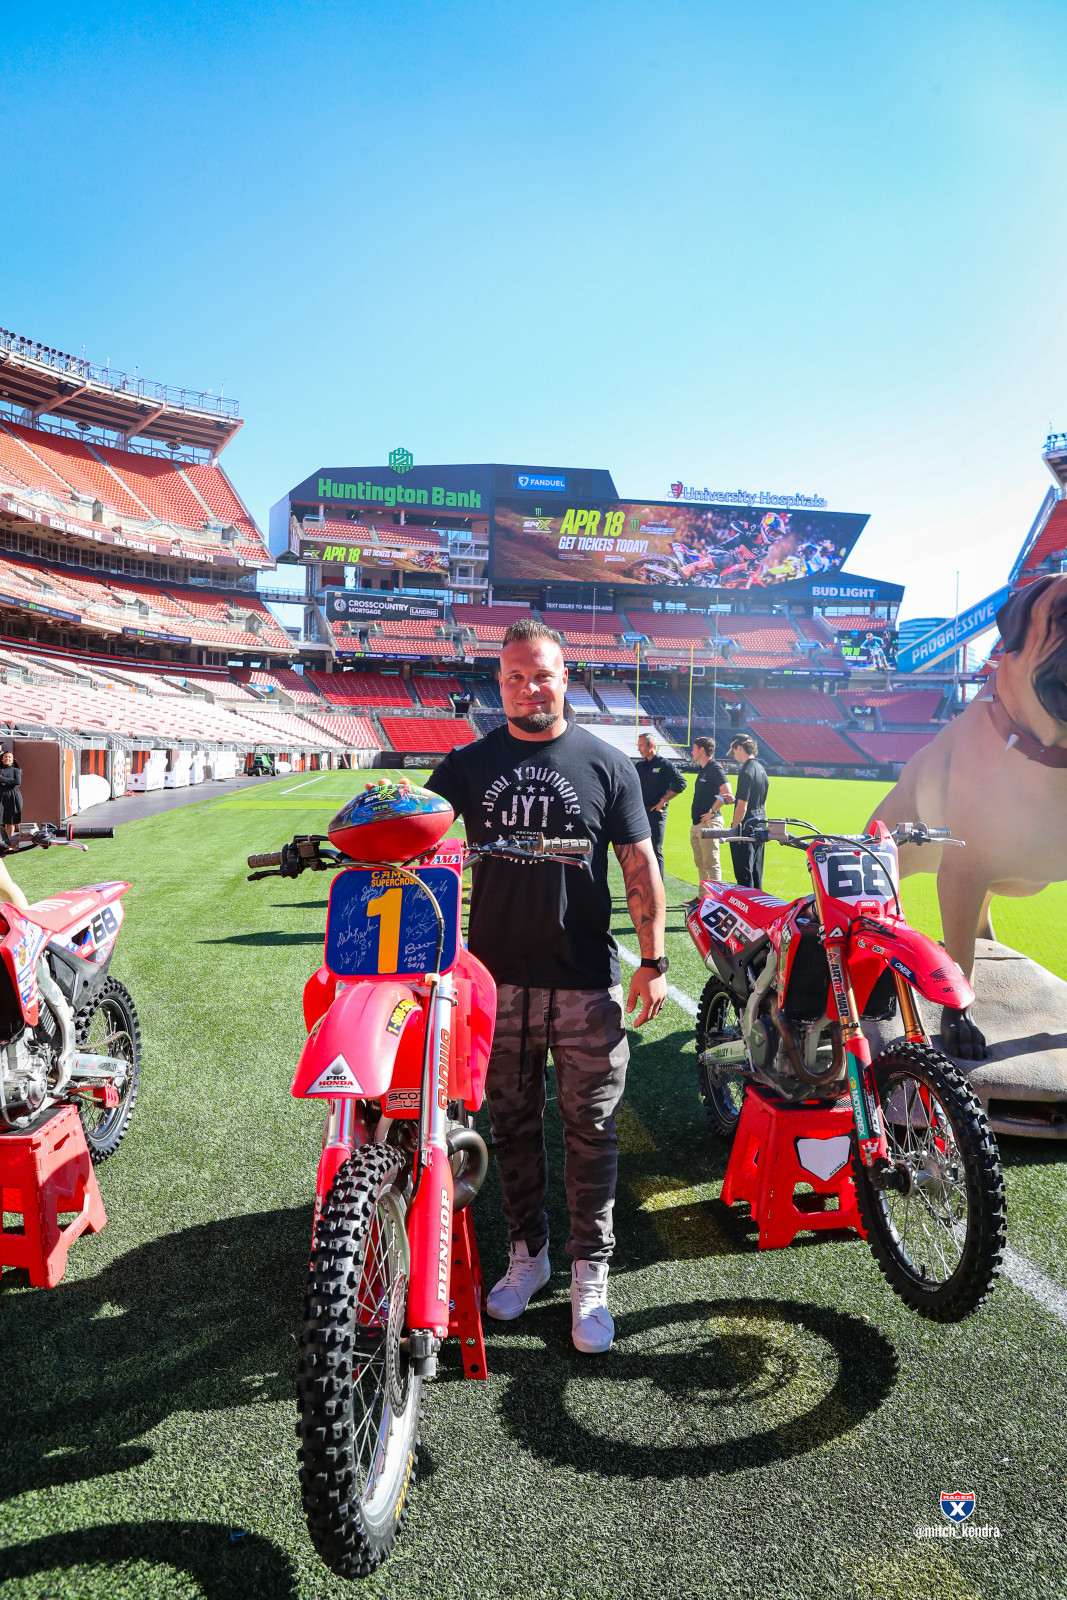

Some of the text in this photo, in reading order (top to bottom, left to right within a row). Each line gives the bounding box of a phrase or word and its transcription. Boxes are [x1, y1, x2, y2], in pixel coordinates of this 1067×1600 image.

[530, 479, 565, 487] FANDUEL
[318, 478, 482, 509] Huntington Bank
[683, 486, 825, 509] University Hospitals
[523, 519, 552, 531] SMX
[559, 508, 626, 537] APR 18
[558, 536, 649, 553] GET TICKETS TODAY!
[169, 549, 214, 563] JOE THOMAS 73
[322, 545, 347, 561] APR
[347, 547, 361, 563] 18
[812, 586, 876, 598] BUD LIGHT
[348, 599, 409, 612] CROSSCOUNTRY
[348, 606, 382, 616] MORTGAGE
[411, 608, 437, 617] LANDING
[912, 601, 996, 664] PROGRESSIVE
[364, 788, 395, 804] SMX
[501, 794, 555, 828] JYT
[431, 855, 460, 865] AMA
[371, 877, 419, 887] SUPERCROS
[827, 855, 895, 898] 68
[728, 896, 749, 914] HONDA
[91, 906, 120, 945] 68
[366, 887, 403, 974] 1
[690, 919, 703, 938] HGS
[701, 905, 738, 939] 68
[388, 1092, 422, 1102] SCO
[851, 1089, 866, 1137] MOTOREX
[437, 1188, 451, 1305] DUNLOP
